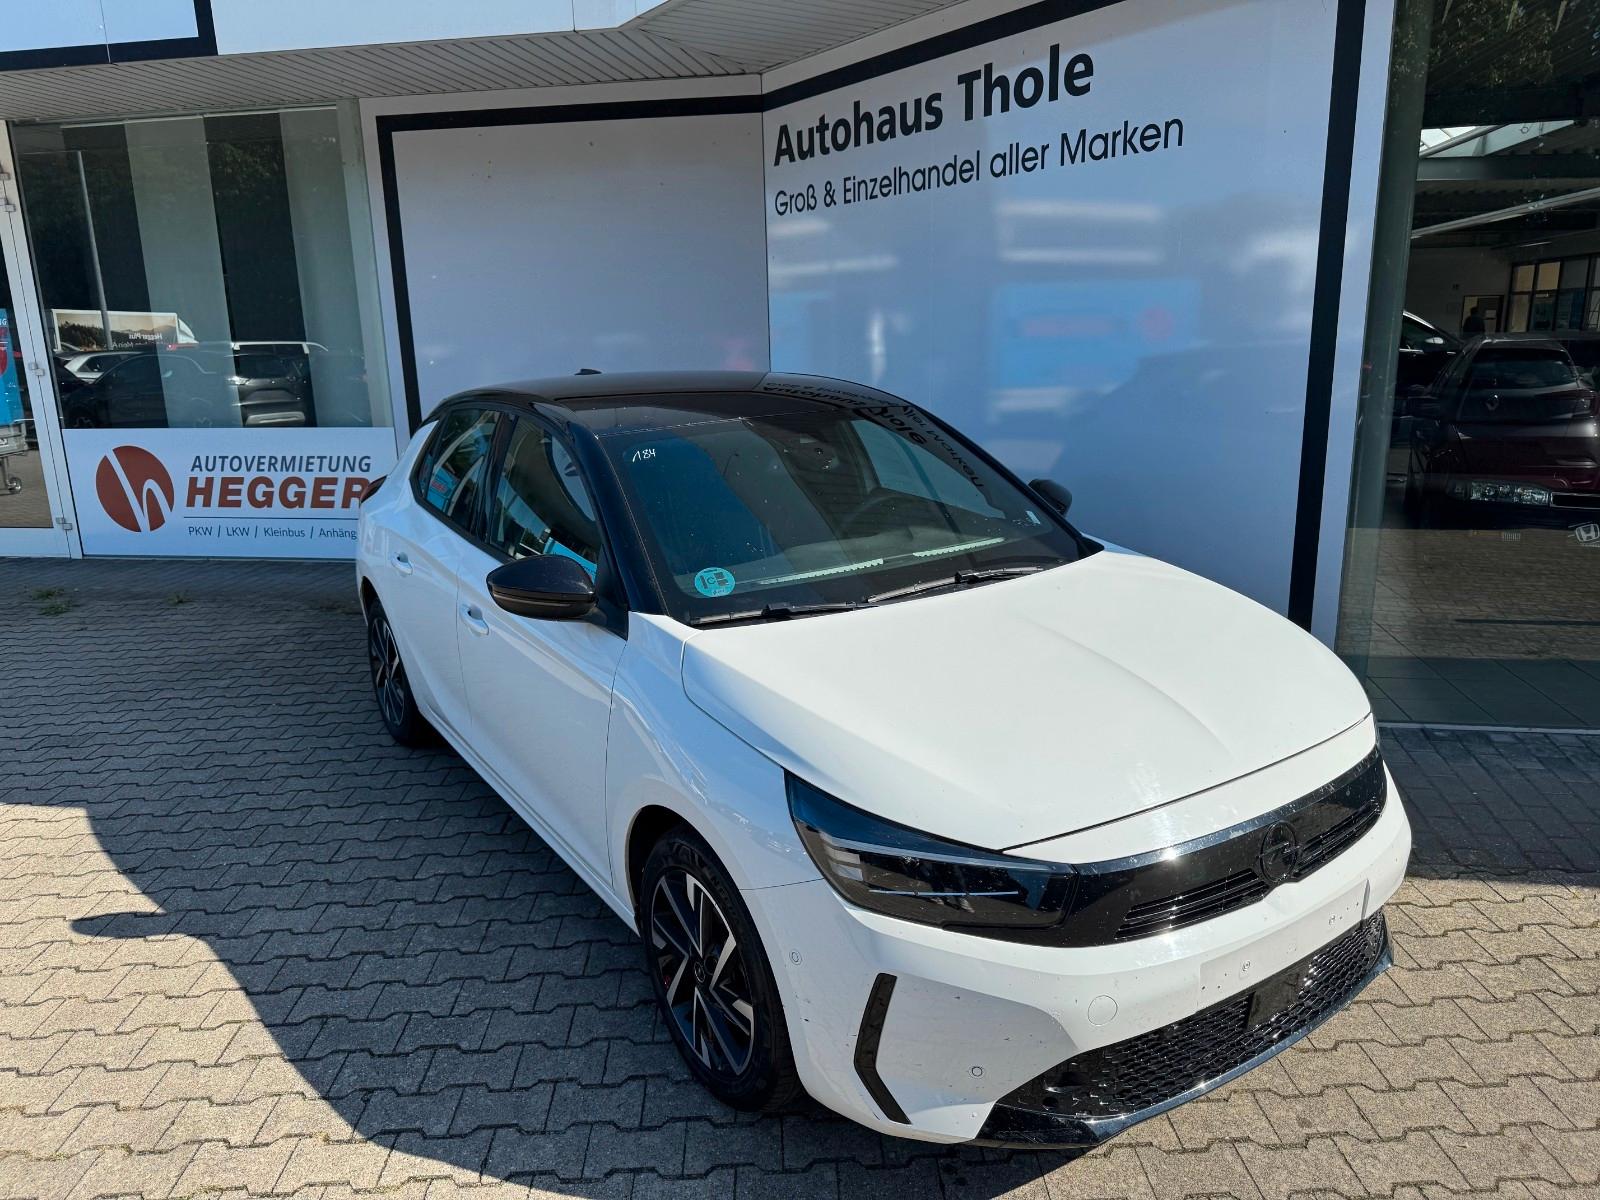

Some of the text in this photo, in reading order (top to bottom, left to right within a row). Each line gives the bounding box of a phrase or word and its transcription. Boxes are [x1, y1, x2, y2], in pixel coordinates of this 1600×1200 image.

[773, 43, 1094, 167] Autohaus Thole
[774, 118, 1185, 217] Groß & Einzelhandel aller Marken
[190, 454, 372, 473] AUTOVERMIETUNG
[186, 476, 371, 509] HEGGER
[188, 526, 213, 537] PKW
[226, 526, 250, 537] LKW
[263, 526, 306, 538] Kleinbus
